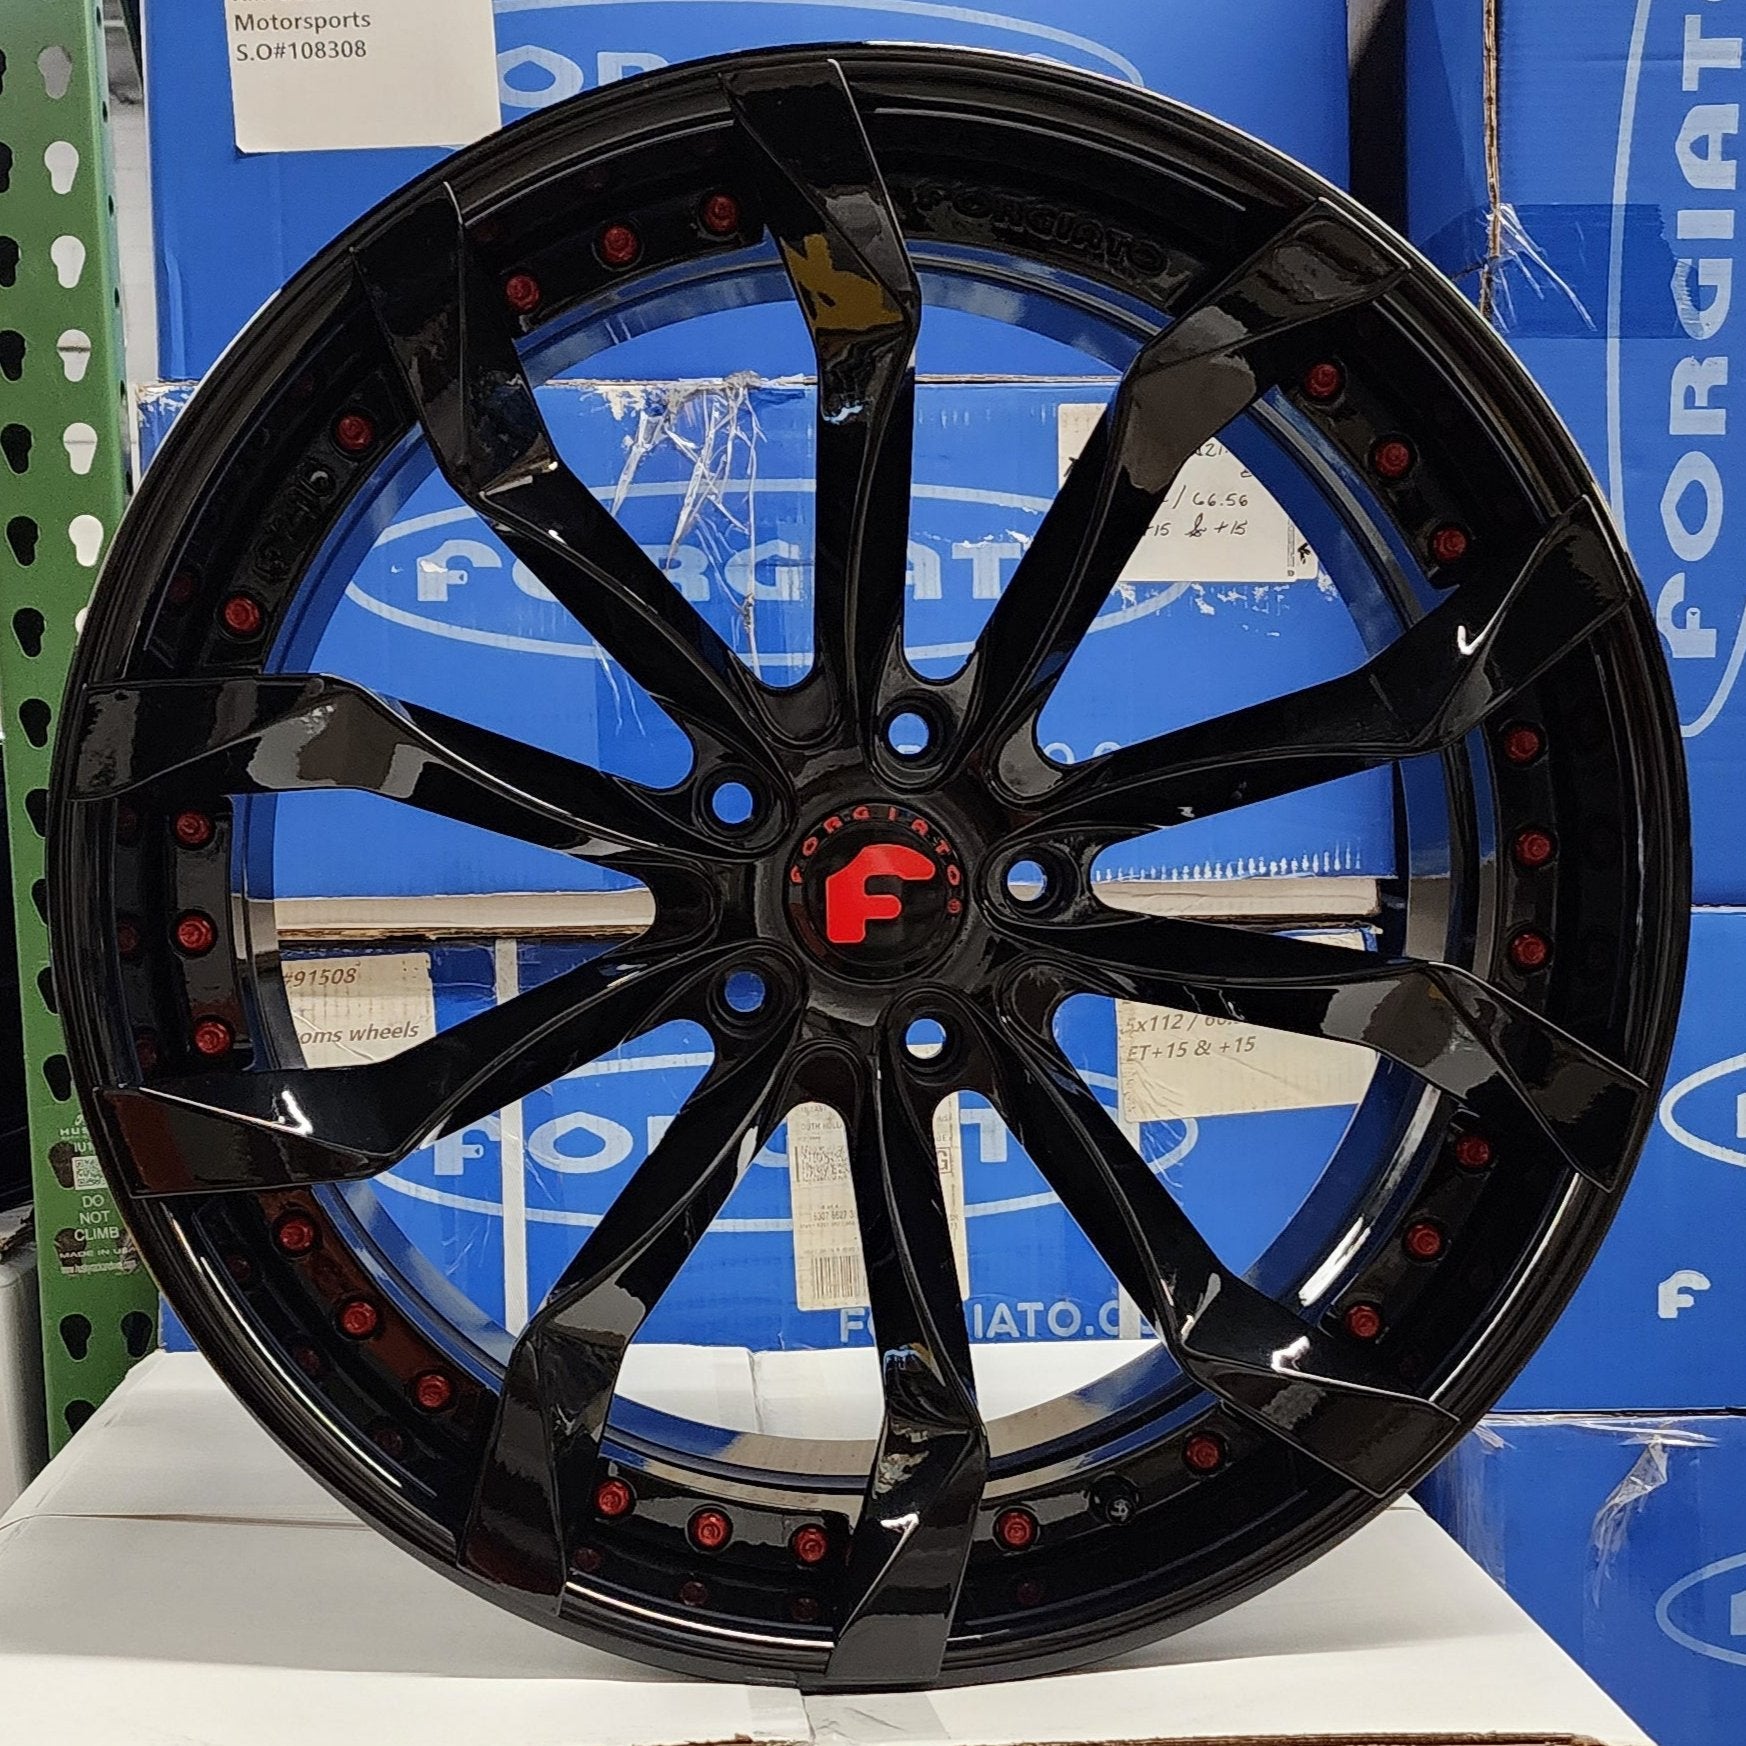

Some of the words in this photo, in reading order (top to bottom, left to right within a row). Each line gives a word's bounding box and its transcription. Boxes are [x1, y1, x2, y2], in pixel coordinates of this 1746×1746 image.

[234, 12, 371, 34] Motorsports
[236, 40, 367, 61] S.O#108308
[1654, 0, 1743, 659] FORGIAT
[1192, 492, 1249, 507] 66.56
[1213, 519, 1249, 536] +15
[349, 1020, 420, 1043] wheels
[1194, 1039, 1213, 1057] &
[1219, 1035, 1257, 1053] +15
[82, 1194, 105, 1208] DO
[79, 1210, 111, 1225] NOT
[74, 1226, 120, 1242] CLIMB
[59, 1250, 94, 1259] MADE
